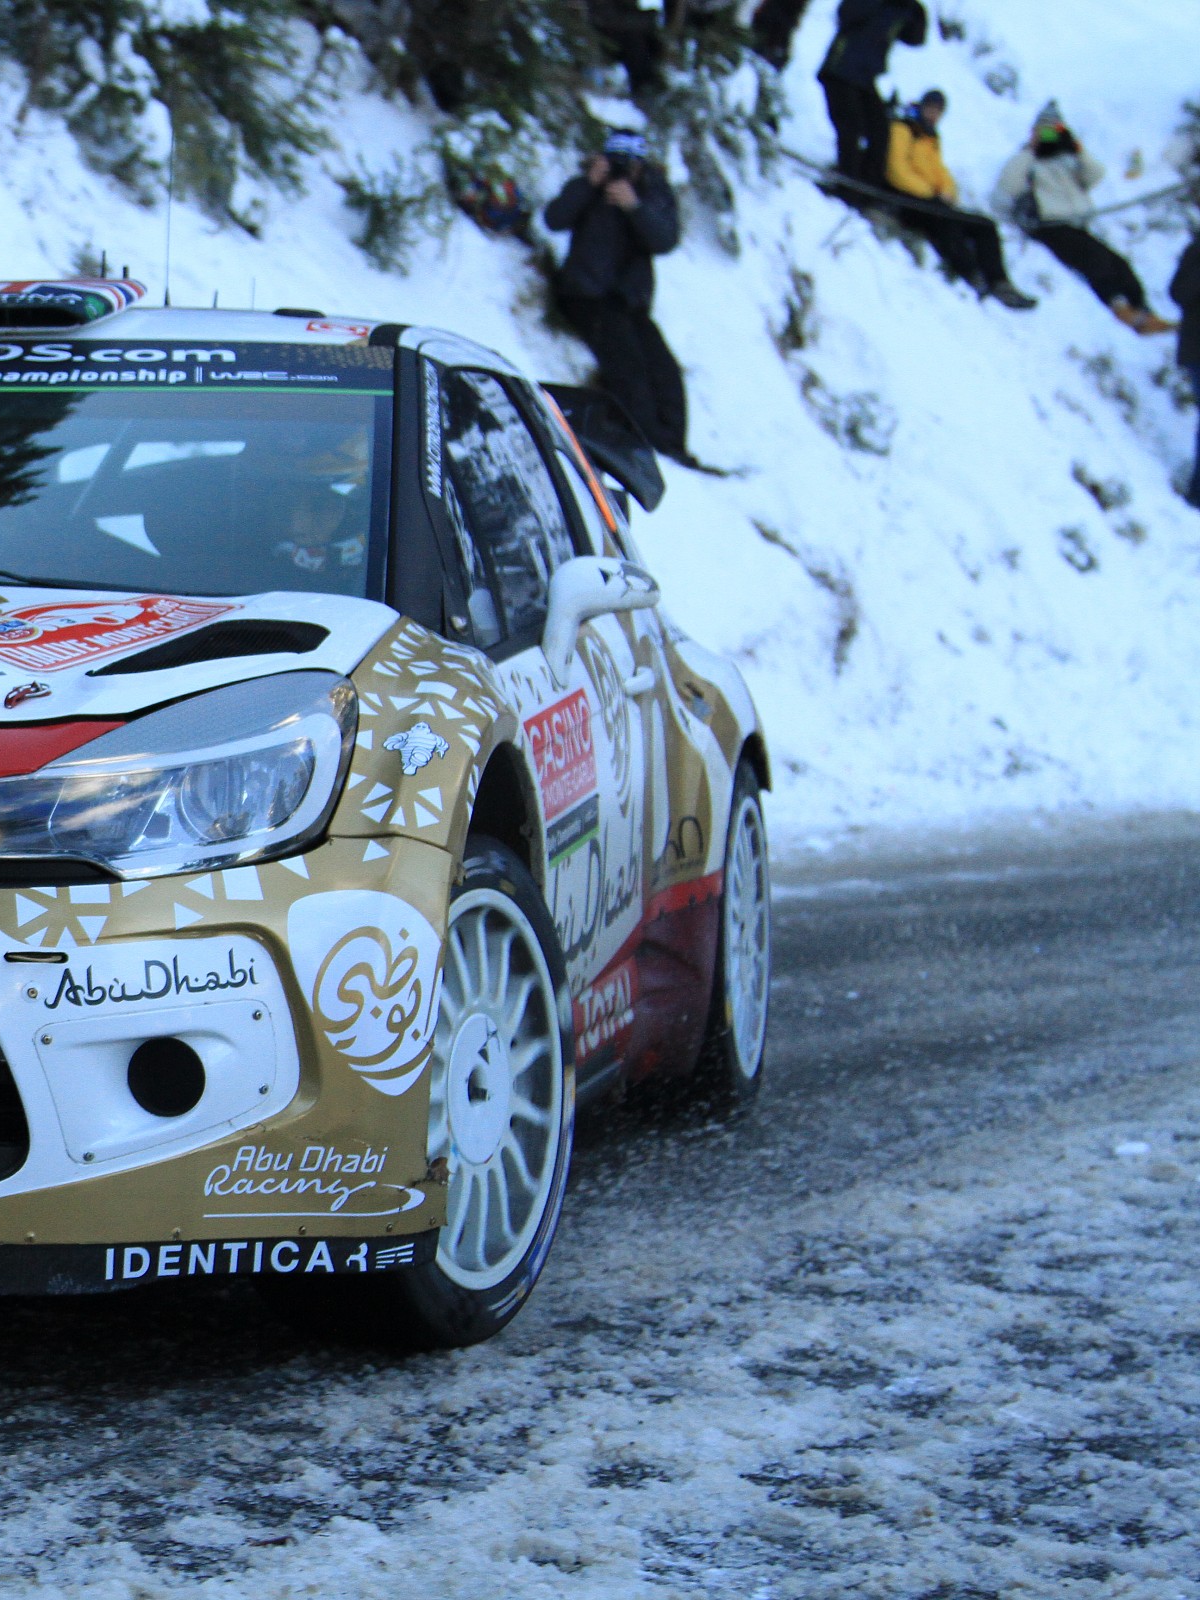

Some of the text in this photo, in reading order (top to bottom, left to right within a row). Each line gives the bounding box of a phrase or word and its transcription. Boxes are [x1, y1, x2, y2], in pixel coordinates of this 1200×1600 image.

[529, 697, 592, 782] CASINO
[232, 1145, 389, 1173] Abu Dhabi
[203, 1165, 378, 1211] Racing
